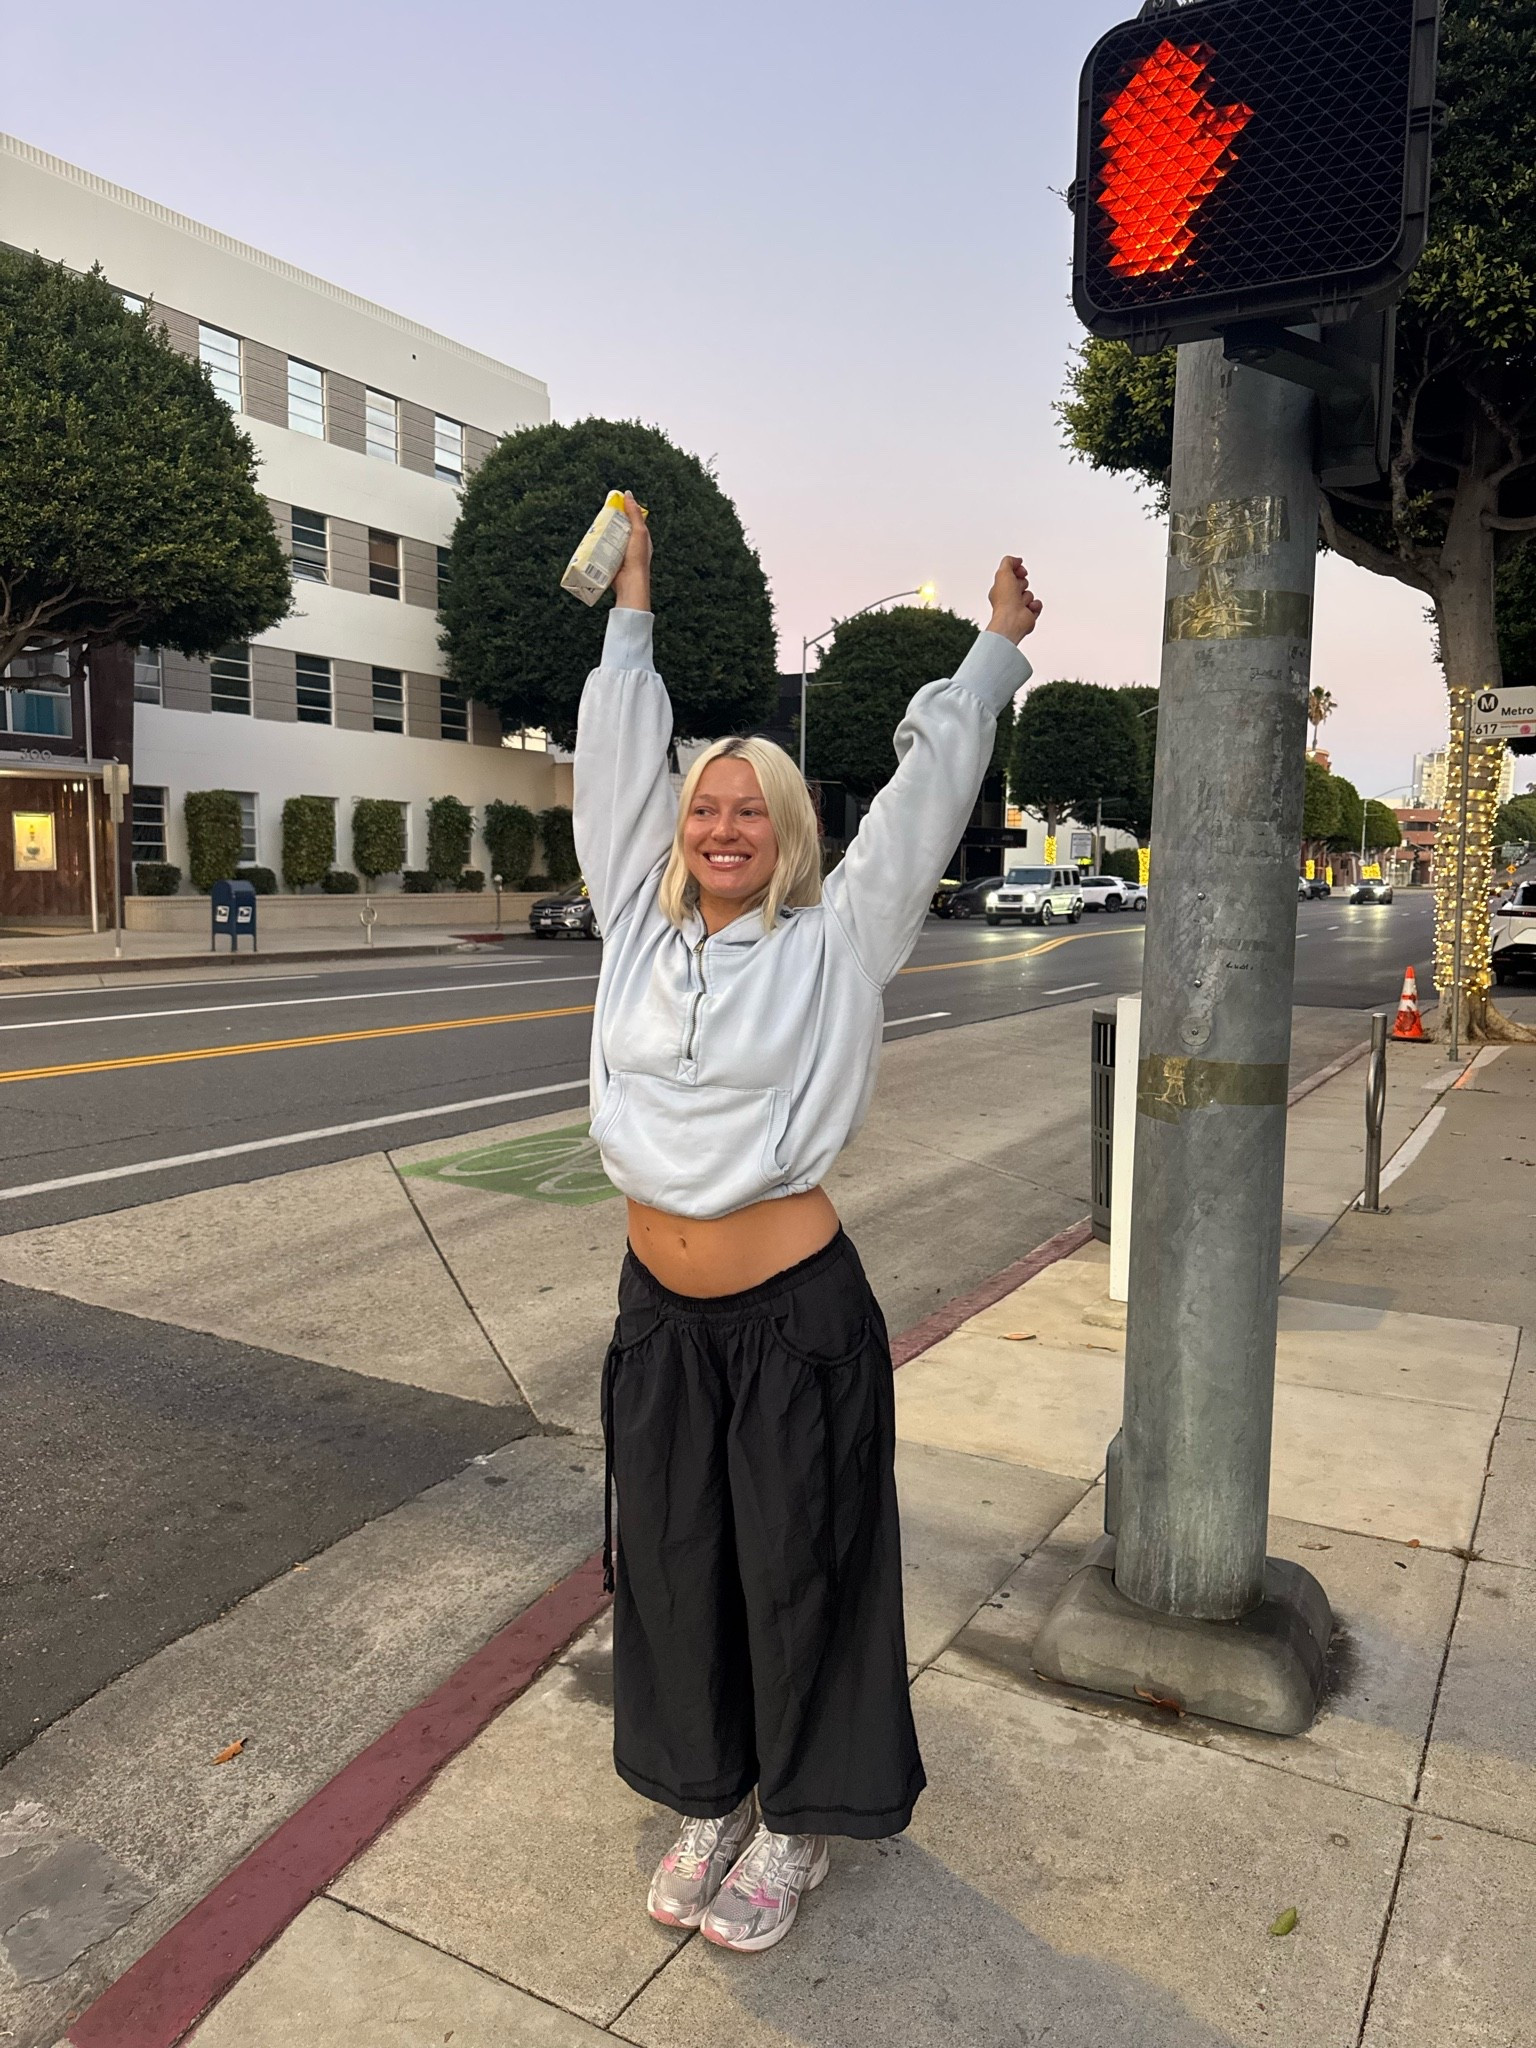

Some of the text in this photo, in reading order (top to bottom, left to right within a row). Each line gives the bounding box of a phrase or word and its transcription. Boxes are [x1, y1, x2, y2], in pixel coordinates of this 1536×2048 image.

[1480, 696, 1496, 711] M
[1501, 707, 1534, 716] Metro
[1475, 723, 1498, 735] 617
[20, 748, 52, 761] 300
